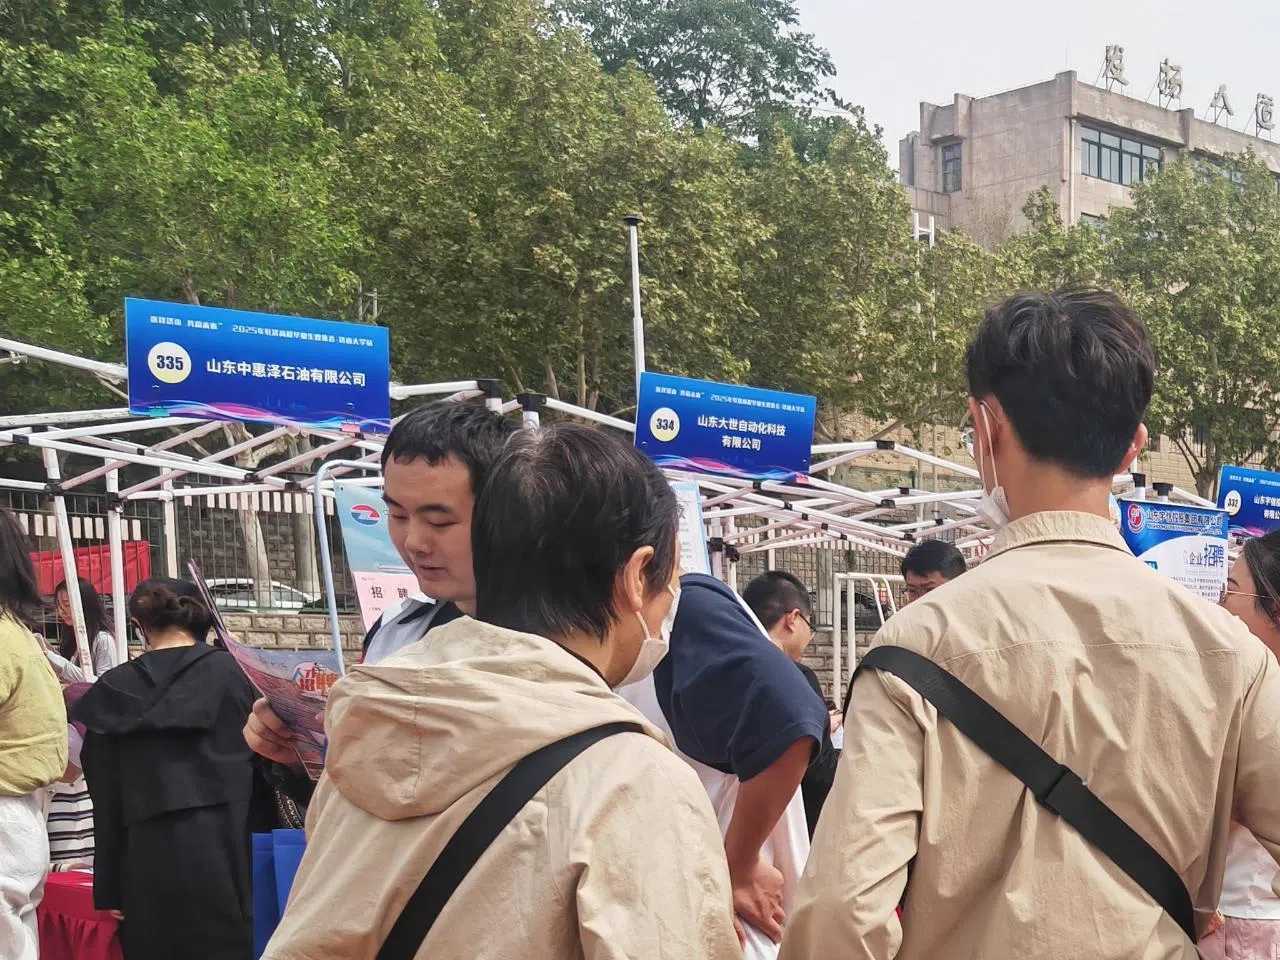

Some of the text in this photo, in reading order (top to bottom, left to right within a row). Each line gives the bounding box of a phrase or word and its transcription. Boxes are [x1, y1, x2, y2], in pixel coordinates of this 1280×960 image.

[156, 354, 184, 371] 335
[206, 358, 366, 387] 山东中惠泽石油有限公司
[656, 417, 675, 432] 334
[697, 414, 787, 437] 山东大世自动化科技
[721, 435, 762, 451] 有限公司
